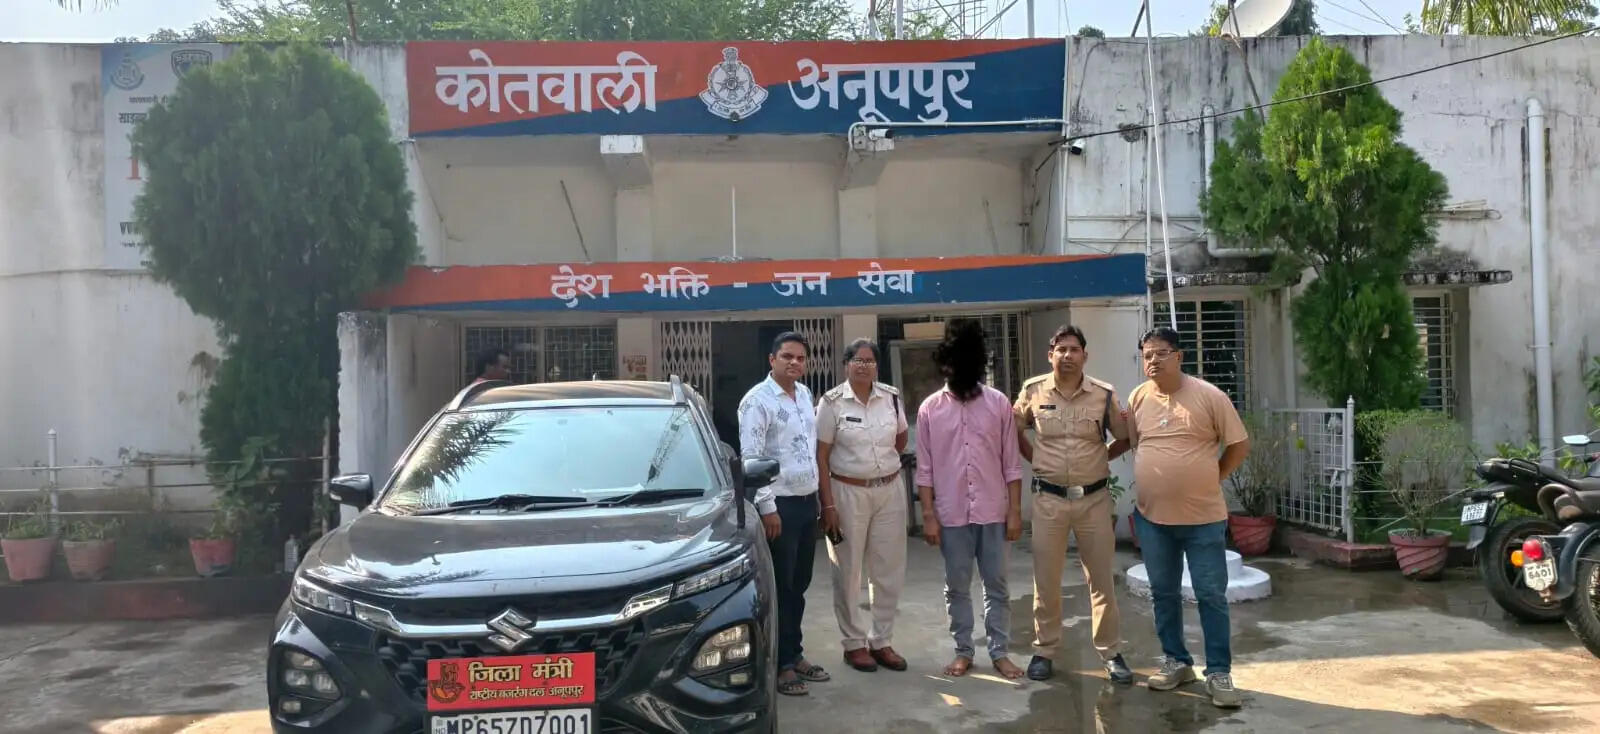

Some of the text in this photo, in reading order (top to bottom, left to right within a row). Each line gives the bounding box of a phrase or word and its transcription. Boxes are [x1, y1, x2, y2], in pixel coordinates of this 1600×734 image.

[435, 49, 976, 123] कोतवाली अनूपपुर
[551, 265, 612, 307] देश
[640, 267, 709, 299] भक्ति
[771, 271, 831, 296] जन
[857, 261, 914, 295] सेवा
[469, 657, 574, 683] जिला मंत्री
[548, 684, 584, 698] अनूपपुर
